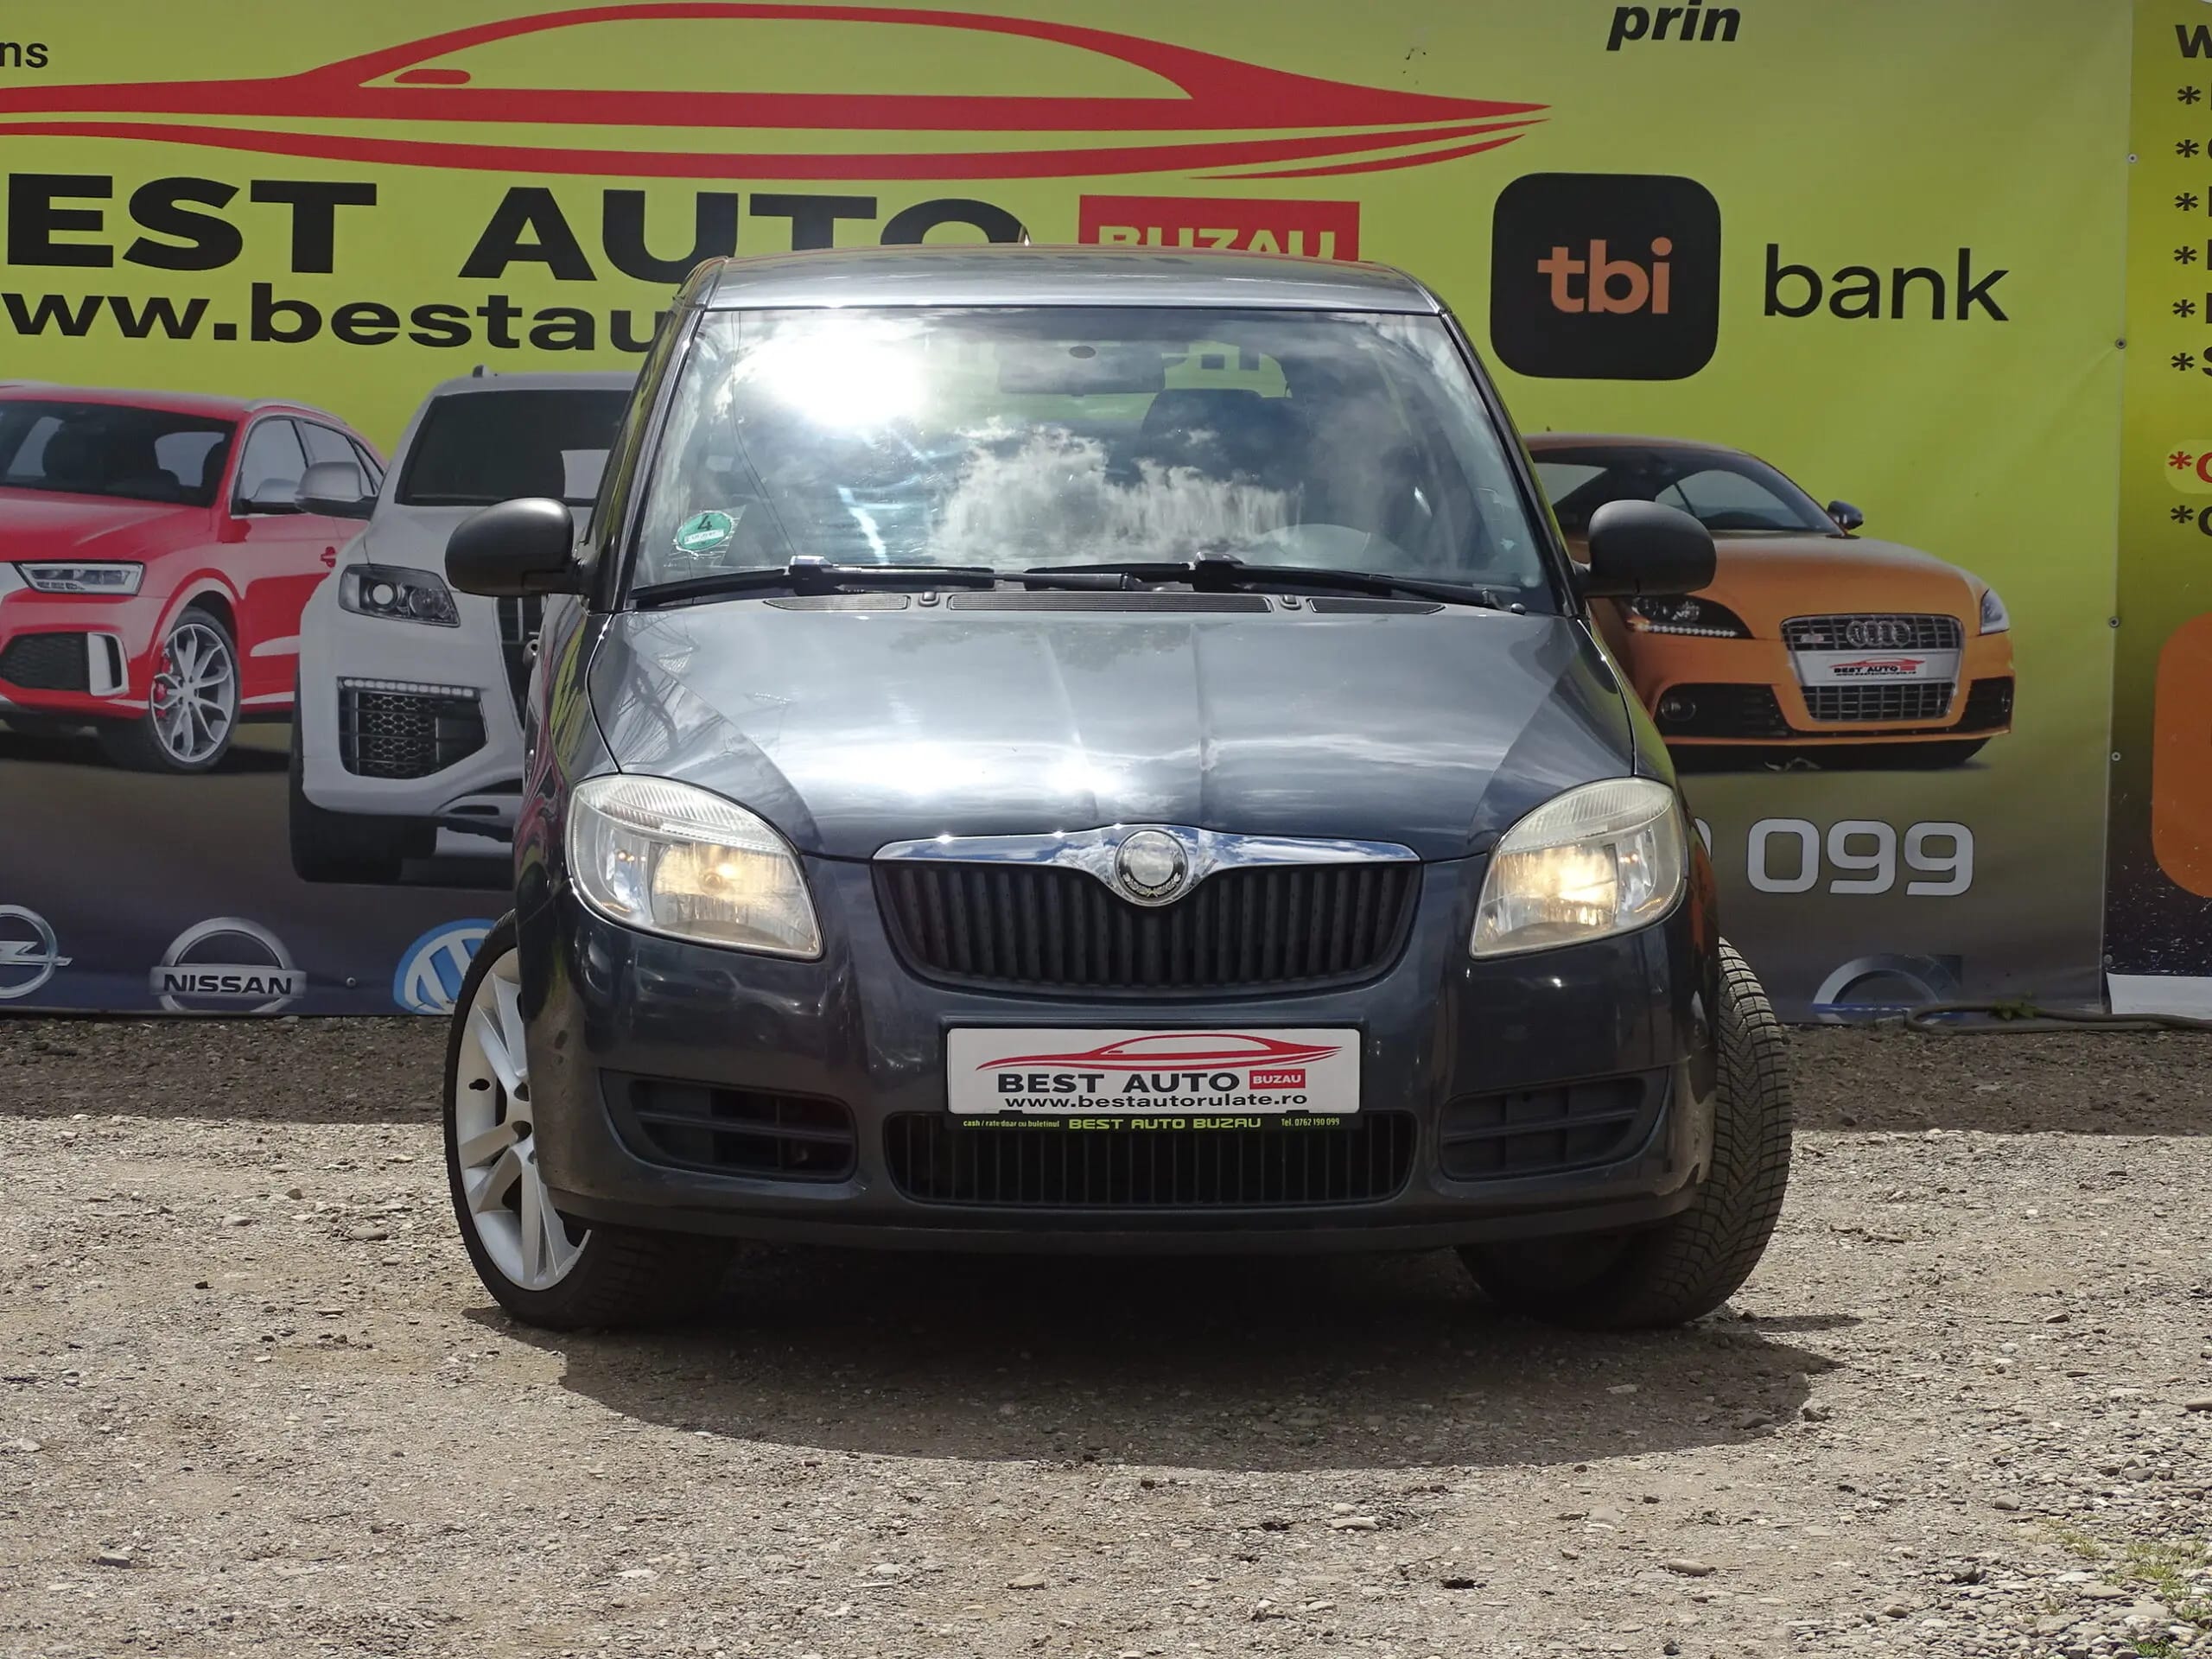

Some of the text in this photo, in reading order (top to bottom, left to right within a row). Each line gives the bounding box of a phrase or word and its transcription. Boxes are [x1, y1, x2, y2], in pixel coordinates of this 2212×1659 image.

[1606, 0, 1740, 50] prin
[1537, 237, 1673, 315] tbi
[1764, 243, 2008, 321] bank
[1748, 818, 1974, 896] 099
[164, 974, 292, 995] NISSAN
[998, 1072, 1301, 1093] BEST AUTO BUZAU
[1005, 1093, 1307, 1108] www.bestautorulate.ro
[1068, 1117, 1261, 1129] BEST AUTO BUZAU
[1281, 1118, 1294, 1127] Tel.
[1294, 1118, 1312, 1127] 0762
[1325, 1117, 1340, 1126] 099
